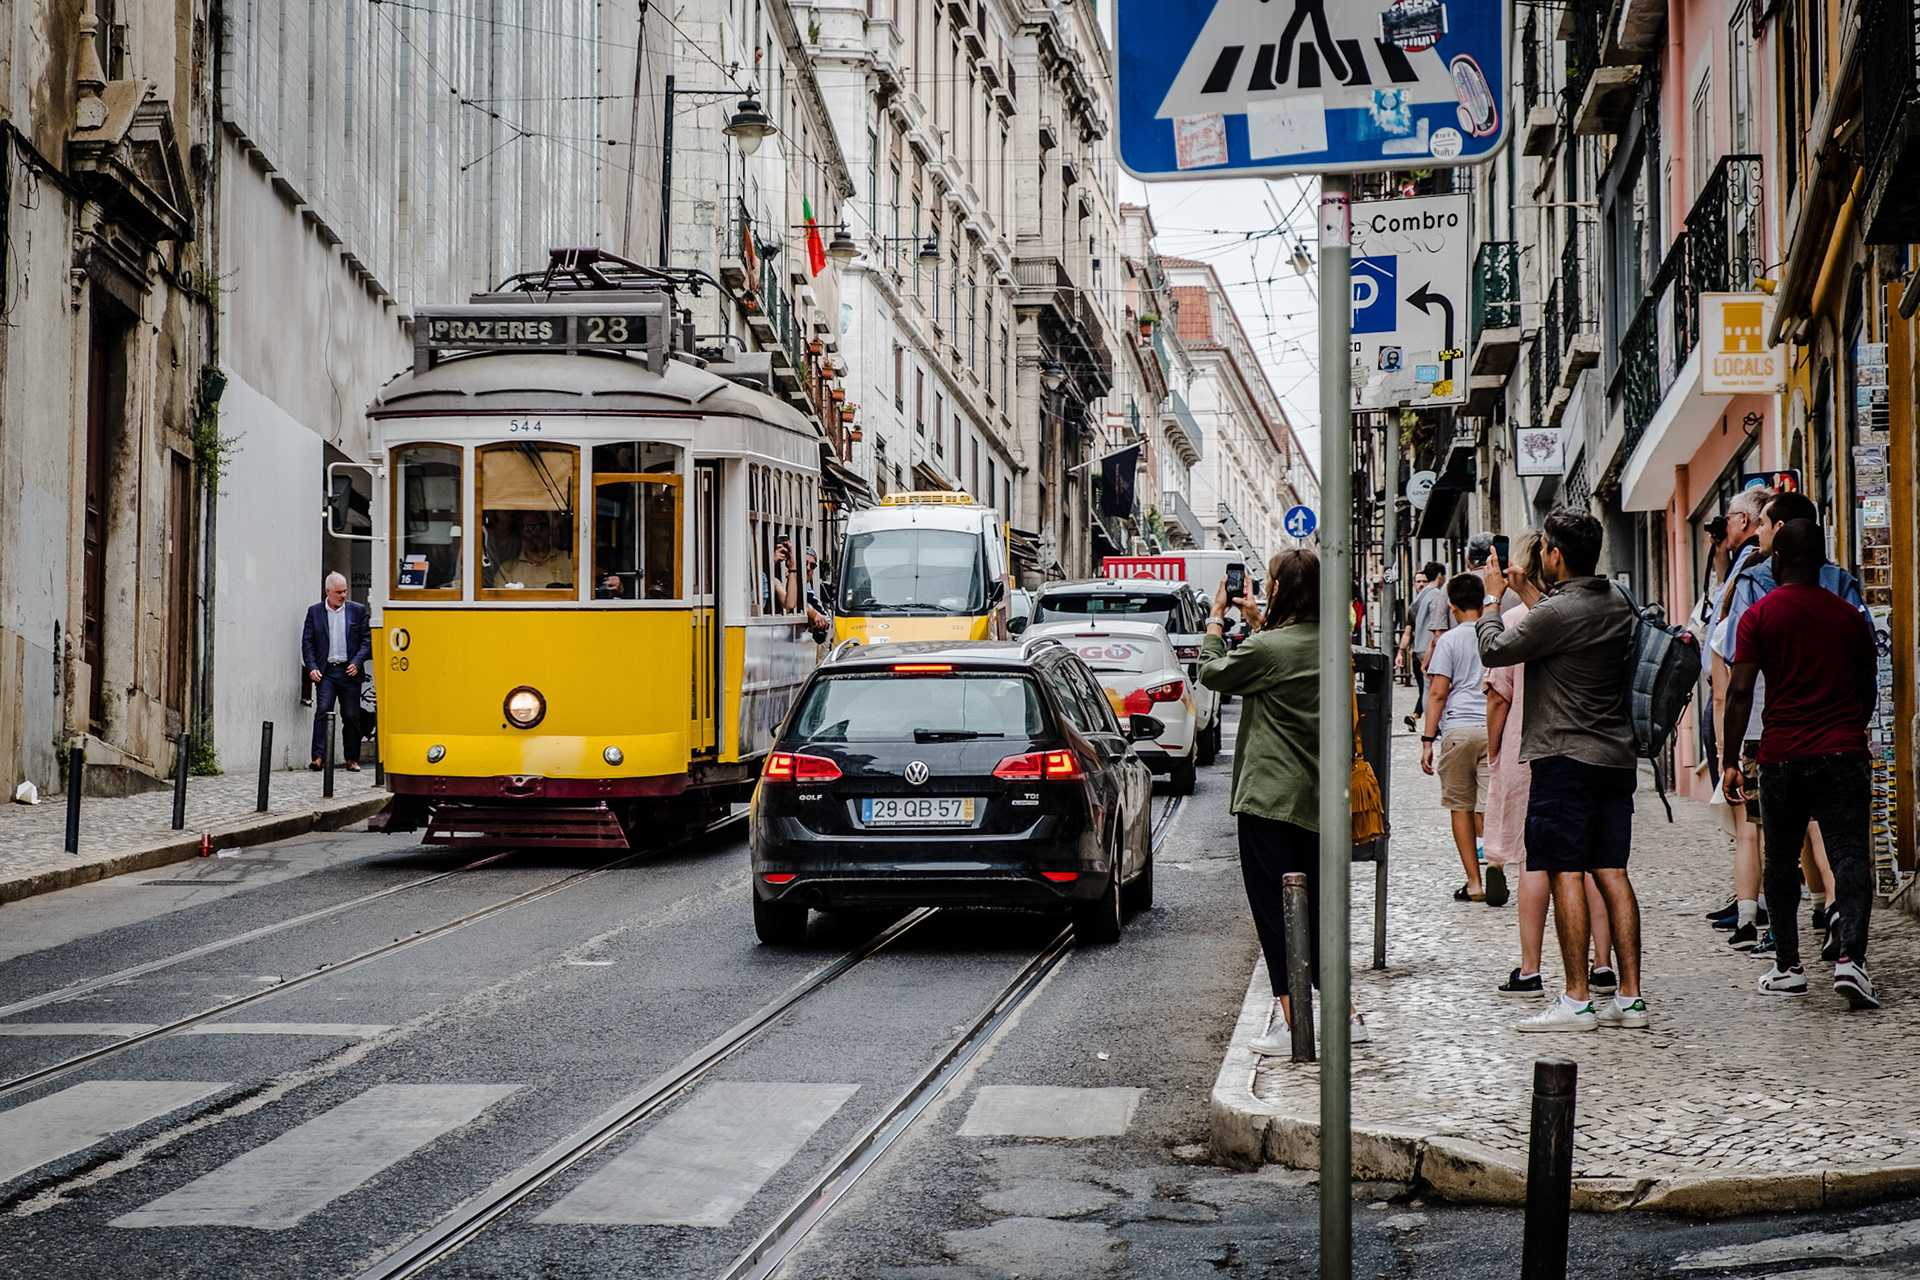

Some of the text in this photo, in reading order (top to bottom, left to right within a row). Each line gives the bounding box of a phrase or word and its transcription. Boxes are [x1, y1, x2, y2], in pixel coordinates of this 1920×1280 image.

[1372, 211, 1459, 233] Combro
[434, 321, 553, 340] PRAZERES
[587, 317, 629, 343] 28
[1713, 357, 1774, 377] LOCALS
[510, 419, 542, 432] 544
[401, 574, 412, 584] 16
